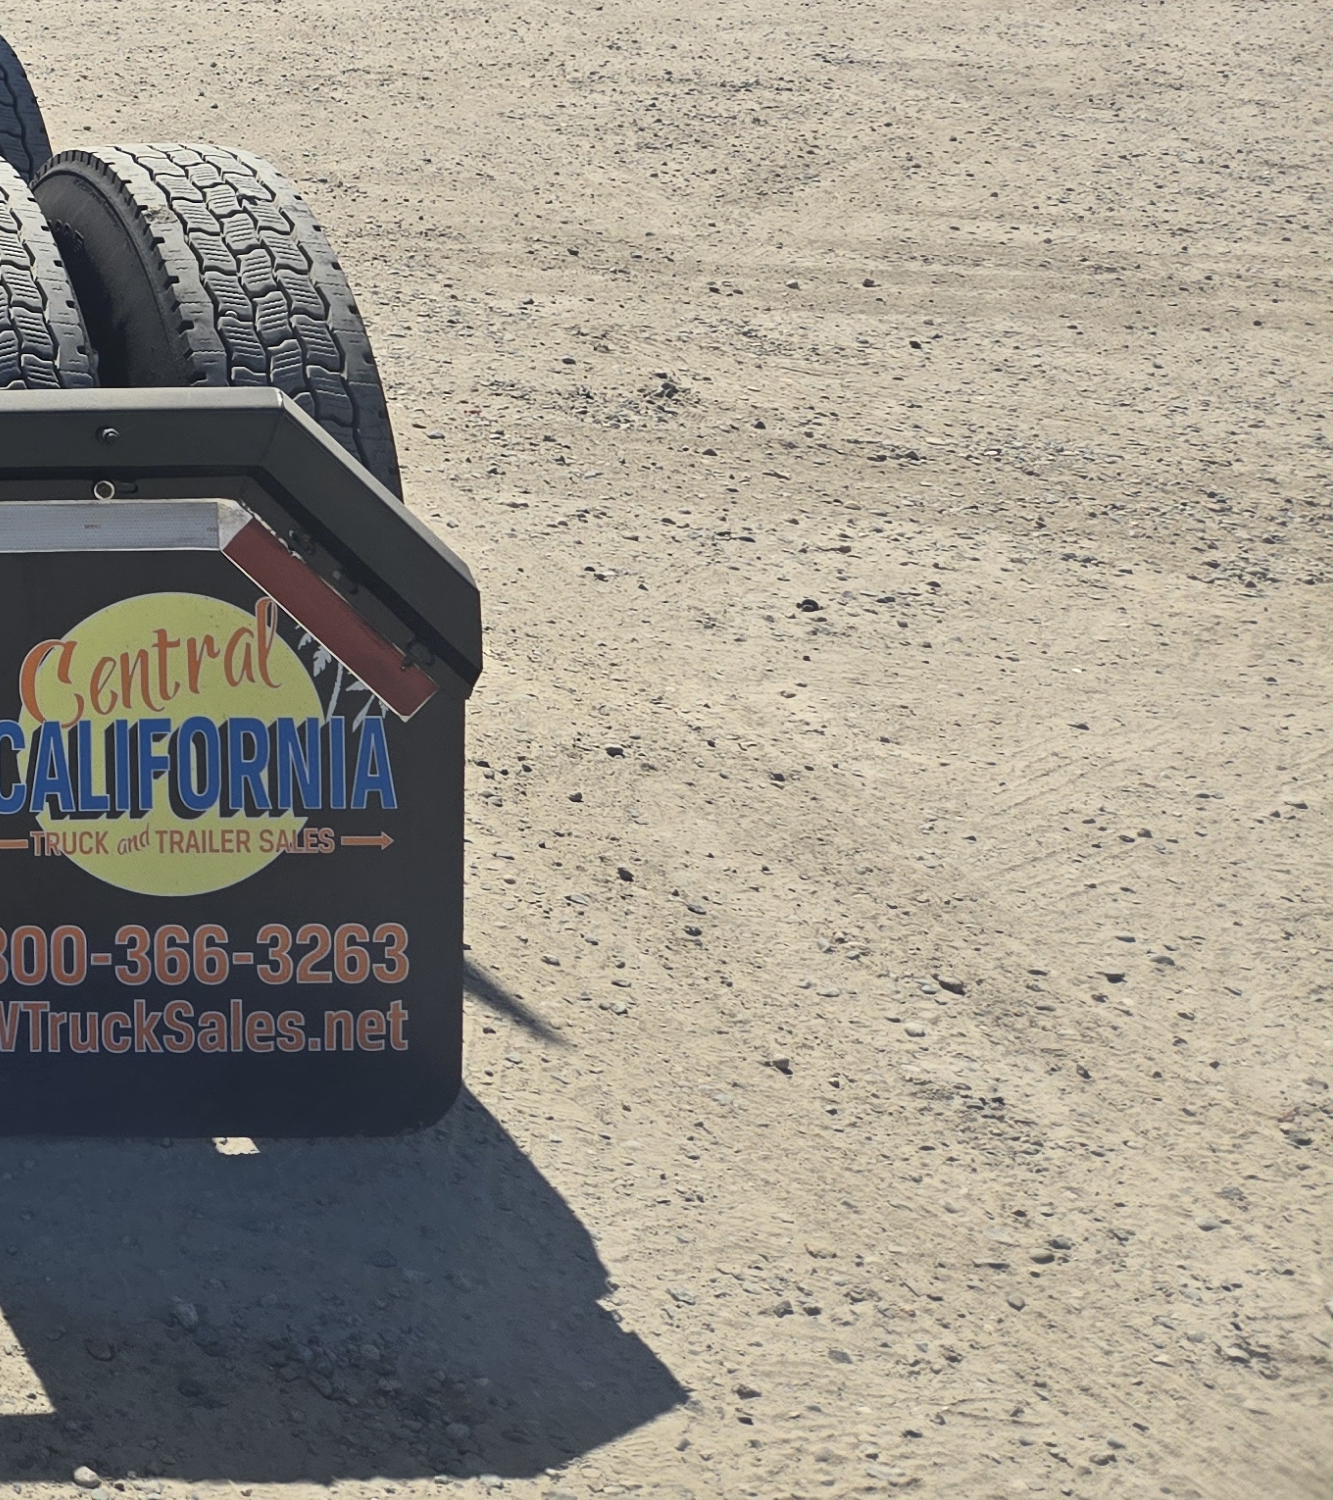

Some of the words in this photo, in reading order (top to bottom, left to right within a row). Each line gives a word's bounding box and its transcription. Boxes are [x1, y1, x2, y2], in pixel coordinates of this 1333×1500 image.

[19, 596, 282, 728] Central
[30, 830, 108, 857] TRUCK
[117, 823, 151, 856] and
[155, 829, 252, 854] TRAILER
[259, 827, 336, 854] SALES
